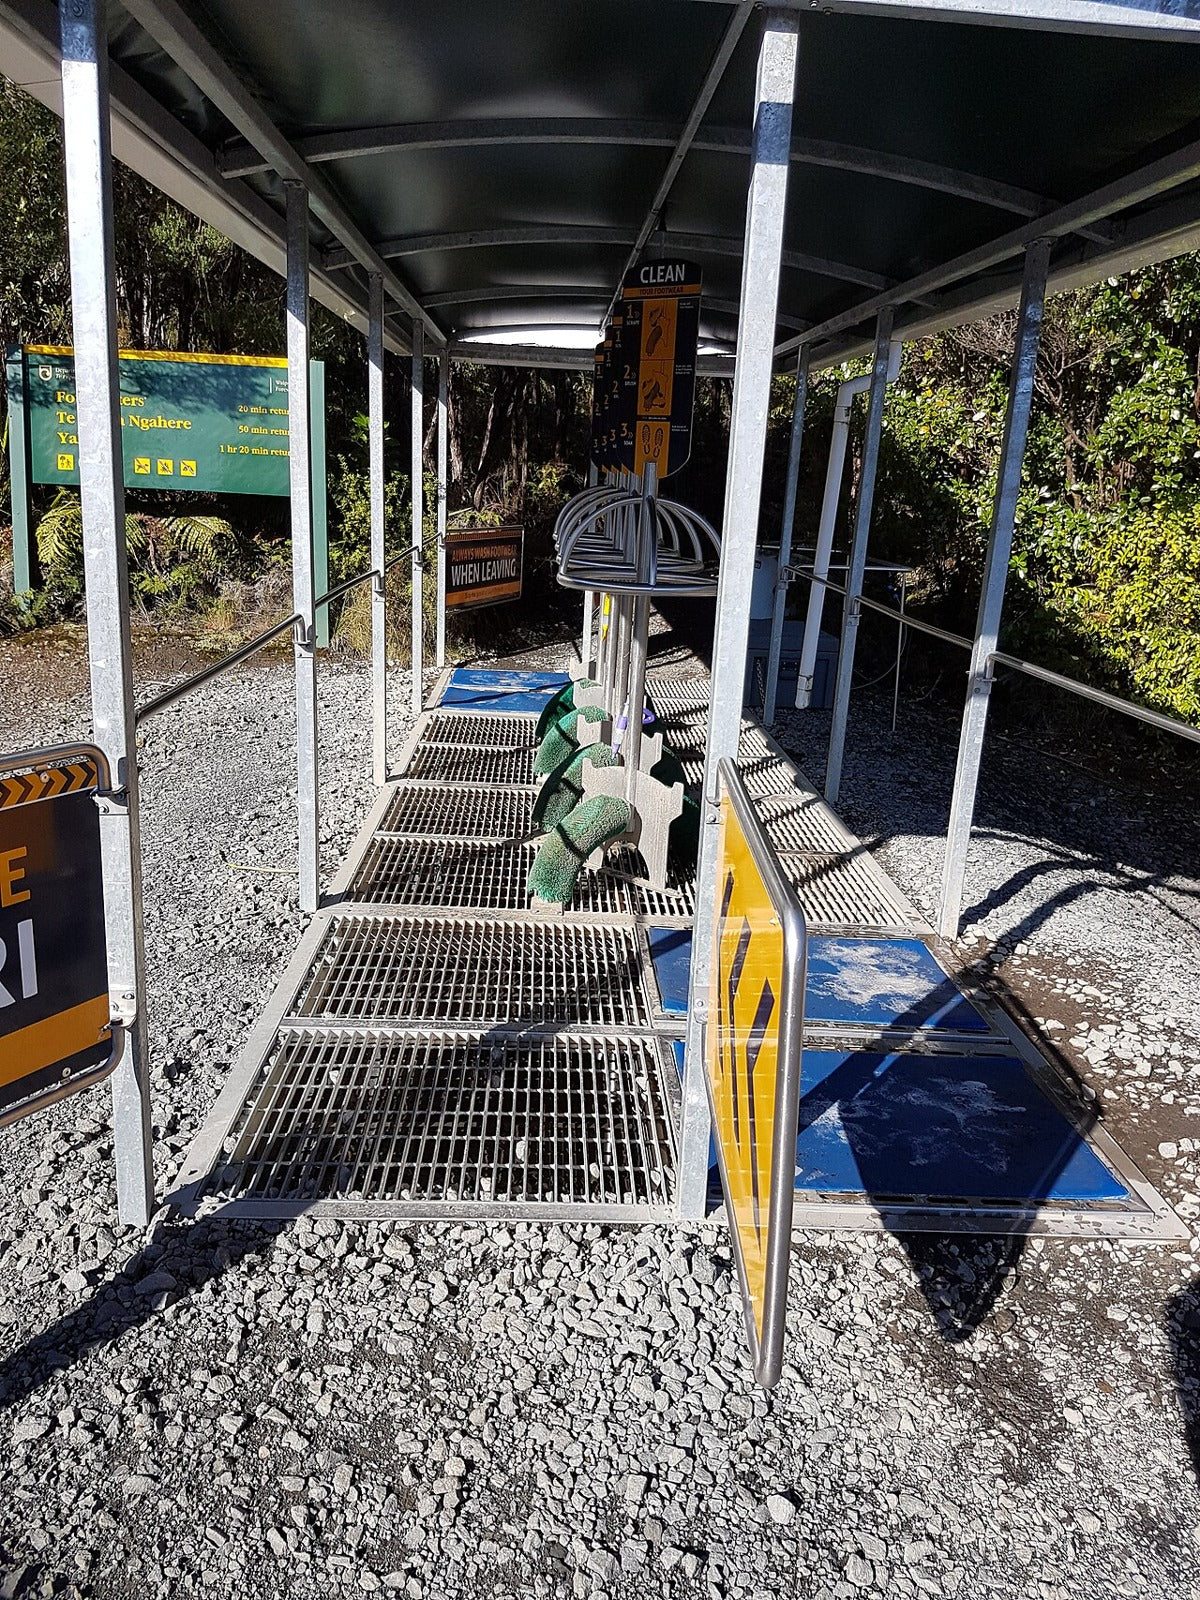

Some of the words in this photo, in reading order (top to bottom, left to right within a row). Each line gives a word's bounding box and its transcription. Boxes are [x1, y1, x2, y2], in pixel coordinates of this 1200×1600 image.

[639, 263, 686, 284] CLEAN
[626, 304, 634, 319] 1
[623, 364, 631, 379] 2
[55, 391, 76, 403] Fo
[238, 404, 249, 413] 20
[250, 406, 267, 414] min
[56, 411, 76, 424] Te
[128, 415, 192, 431] Ngahere
[238, 425, 249, 434] 50
[251, 427, 268, 435] min
[610, 429, 616, 441] 3
[620, 422, 628, 437] 3
[219, 444, 225, 453] 1
[227, 445, 237, 453] hr
[239, 445, 249, 455] 20
[251, 447, 269, 456] min
[270, 449, 291, 457] retur
[451, 547, 474, 562] ALWAYS
[474, 545, 491, 559] WASH
[491, 544, 518, 557] FOOTWEAR
[451, 561, 480, 587] WHEN
[481, 558, 517, 582] LEAVING
